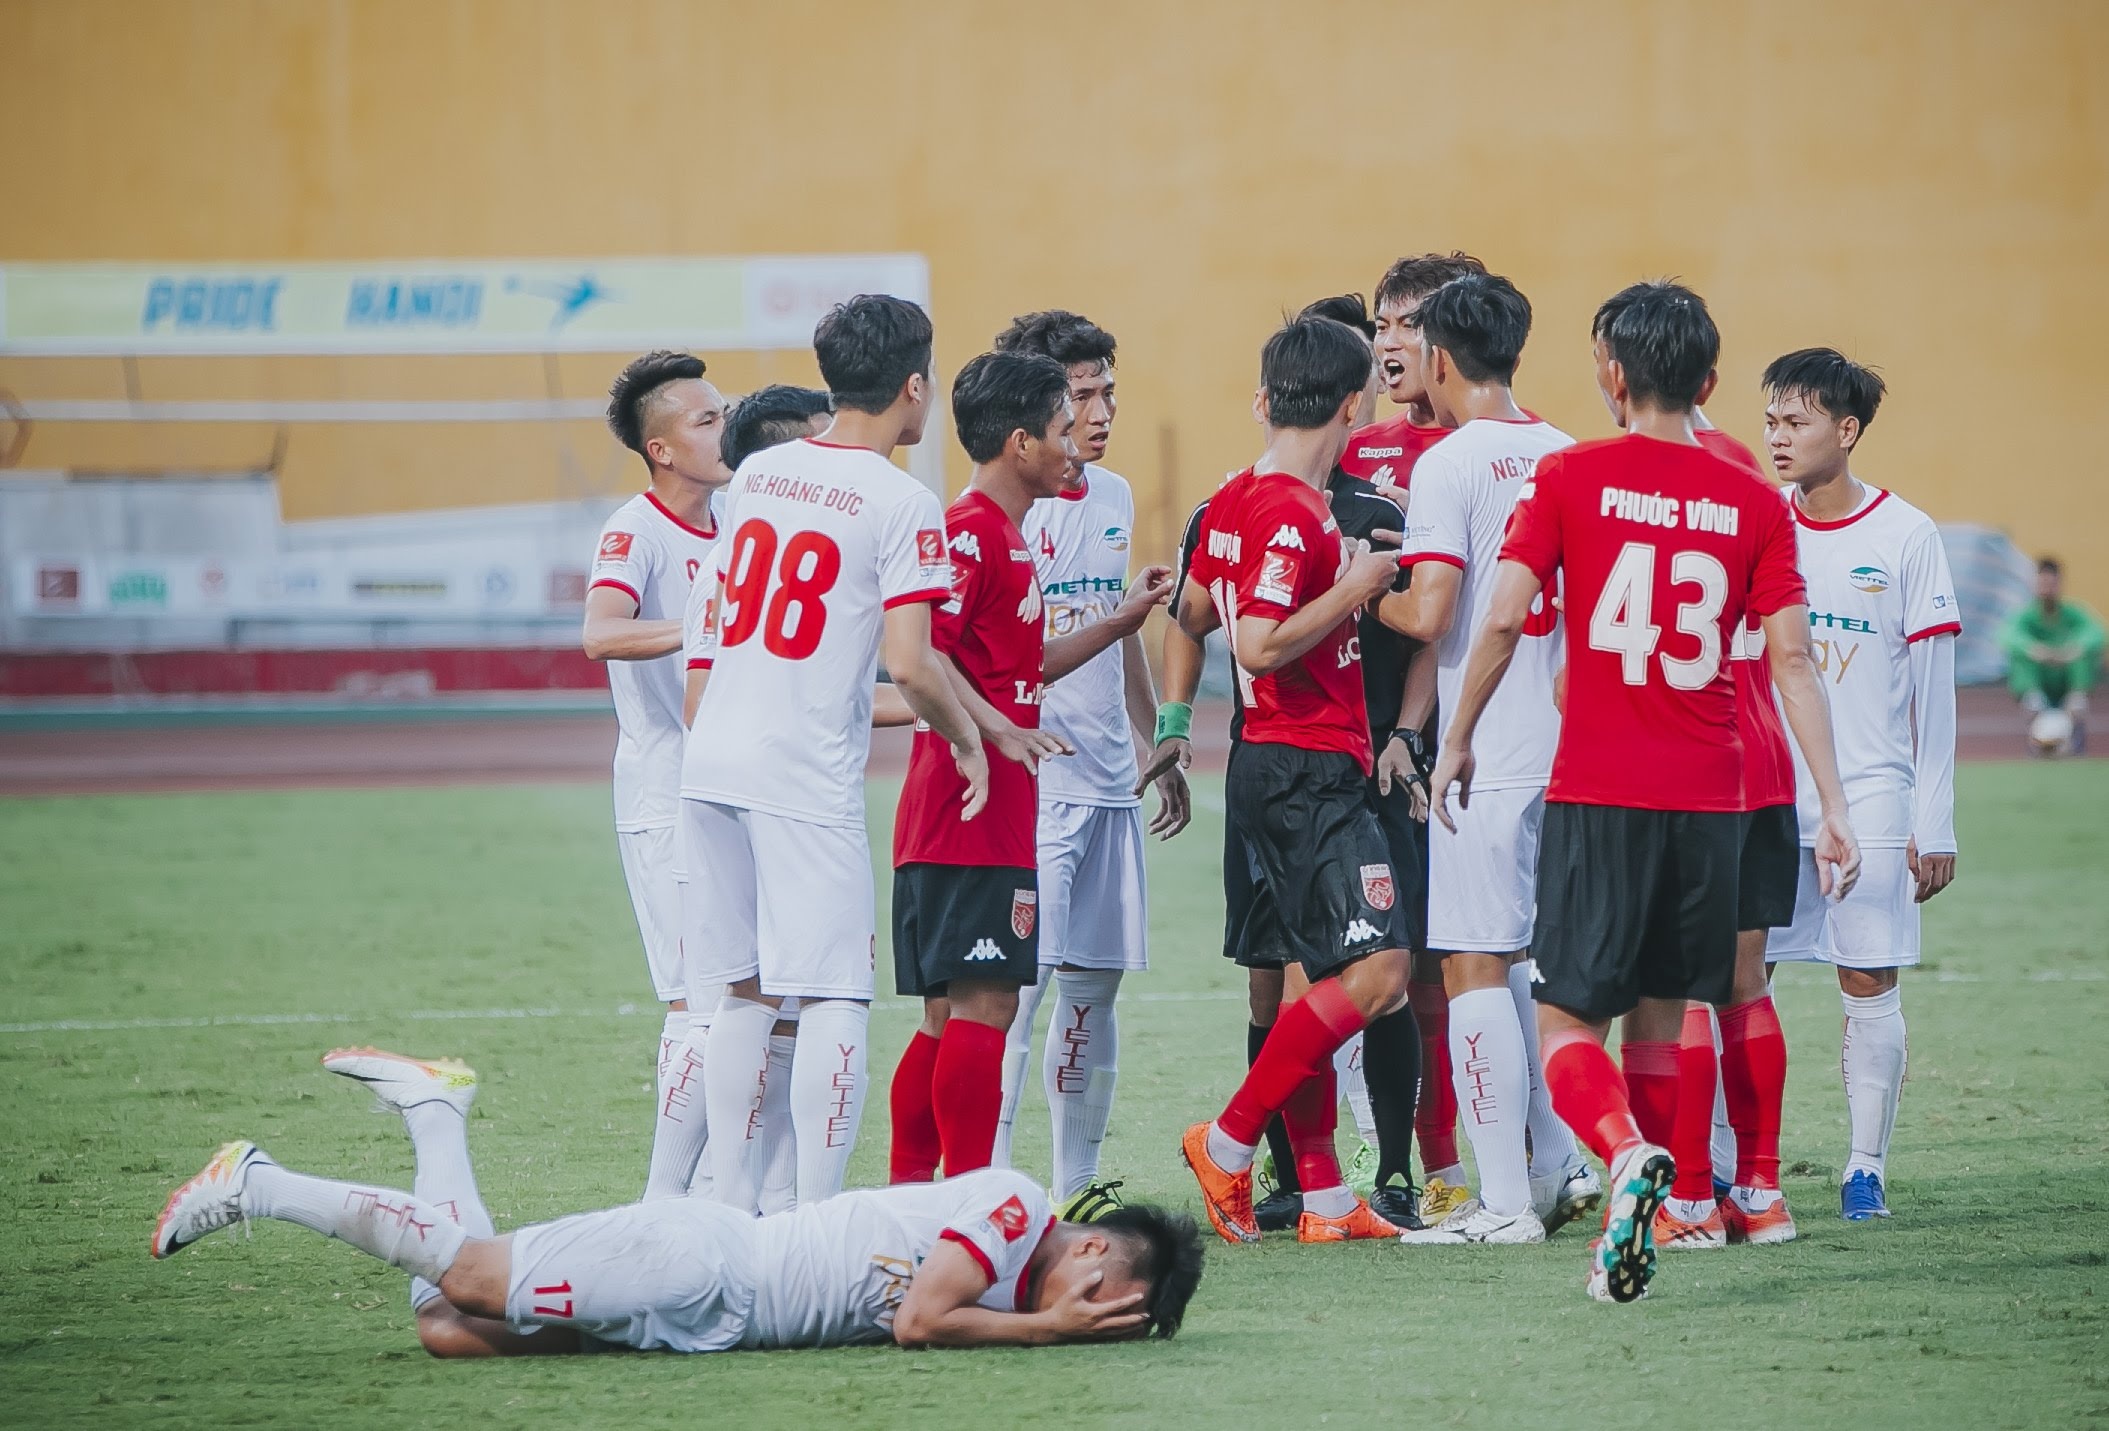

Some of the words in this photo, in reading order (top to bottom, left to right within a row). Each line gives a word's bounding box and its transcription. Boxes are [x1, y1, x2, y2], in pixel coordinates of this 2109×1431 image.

[721, 518, 843, 661] 98
[1588, 541, 1729, 691] 43
[1849, 574, 1890, 586] VIETTEL
[534, 1279, 573, 1319] 17
